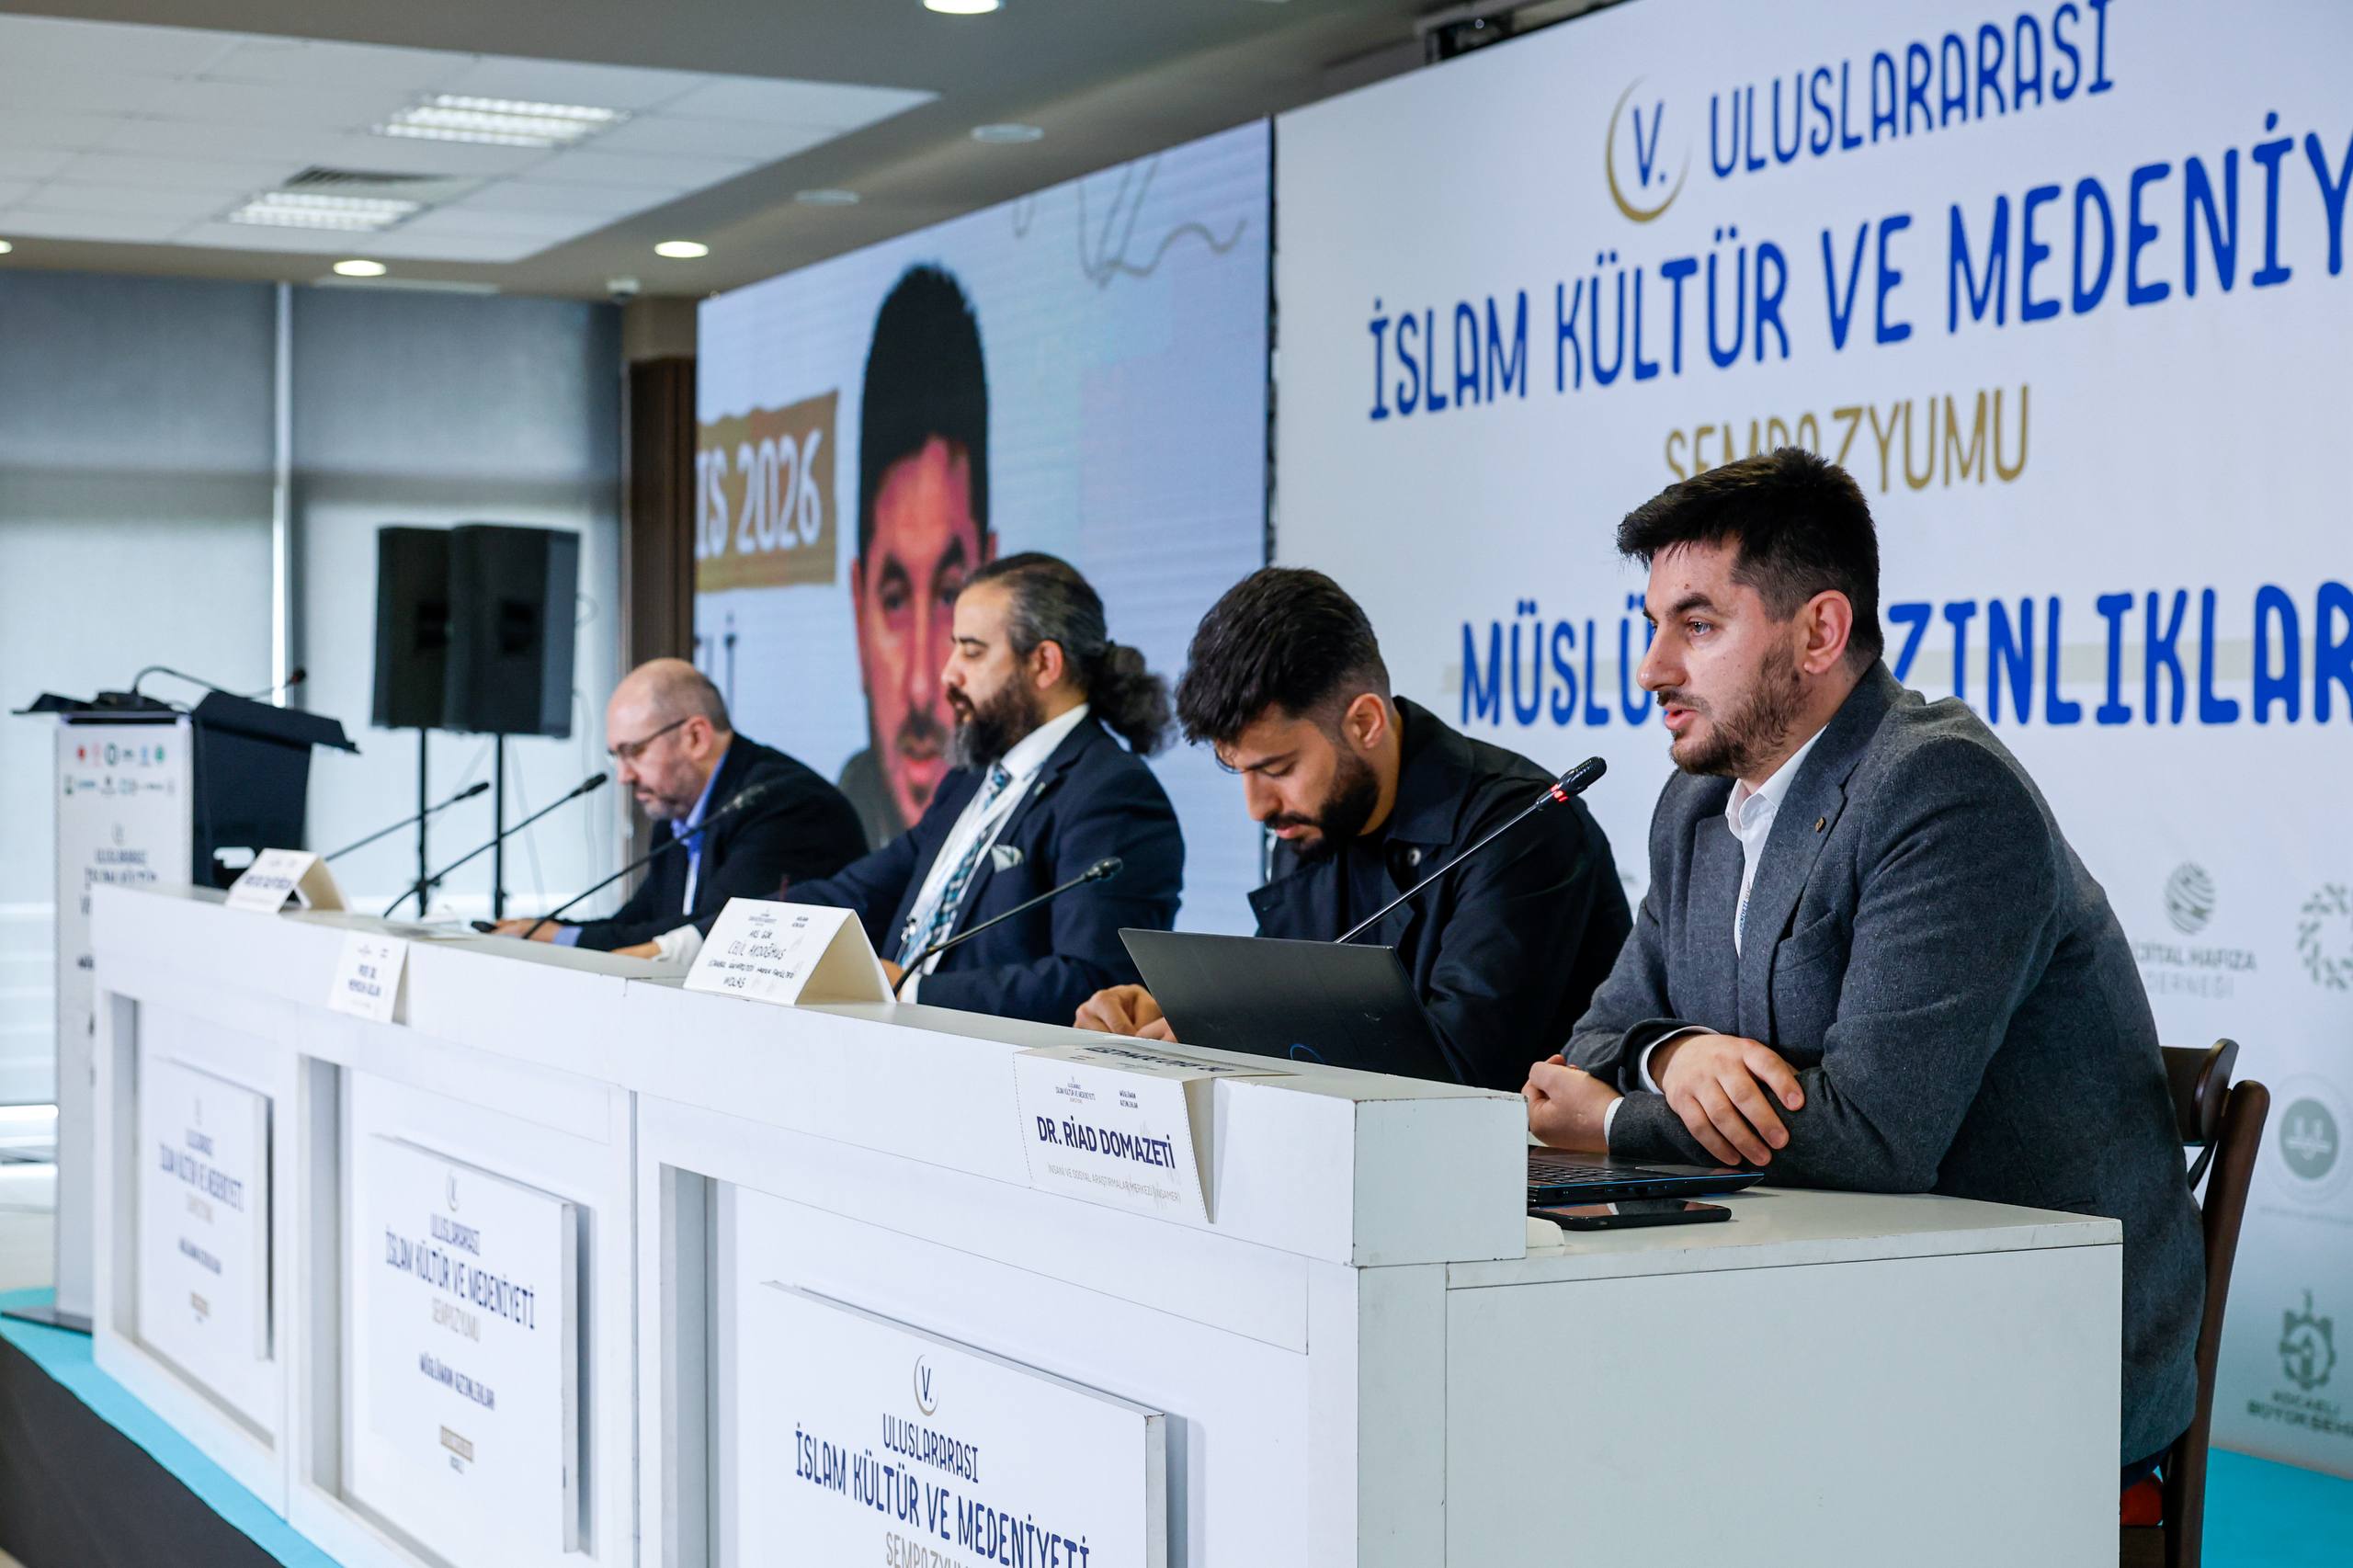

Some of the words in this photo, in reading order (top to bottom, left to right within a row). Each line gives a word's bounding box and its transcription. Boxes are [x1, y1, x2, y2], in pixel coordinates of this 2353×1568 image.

[1633, 102, 1667, 188] V.
[1711, 0, 2115, 180] ULUSLARARASI
[1369, 290, 1529, 421] İSLAM
[1555, 226, 1791, 394] KÜLTÜR
[1821, 213, 1913, 353] VE
[1947, 110, 2353, 335] MEDENİY
[736, 428, 824, 555] 2026
[1461, 593, 1665, 728] MÜSLÜ
[1887, 581, 2353, 727] ZINLIKLAR
[1036, 1115, 1063, 1145] DR.
[1063, 1115, 1097, 1152] RİAD
[1098, 1128, 1176, 1169] DOMAZETİ
[921, 1365, 933, 1403] V.
[796, 1422, 846, 1495] İSLAM
[853, 1449, 920, 1527] KÜLTÜR
[926, 1482, 950, 1540] VE
[882, 1413, 979, 1483] ULUSLARARASI
